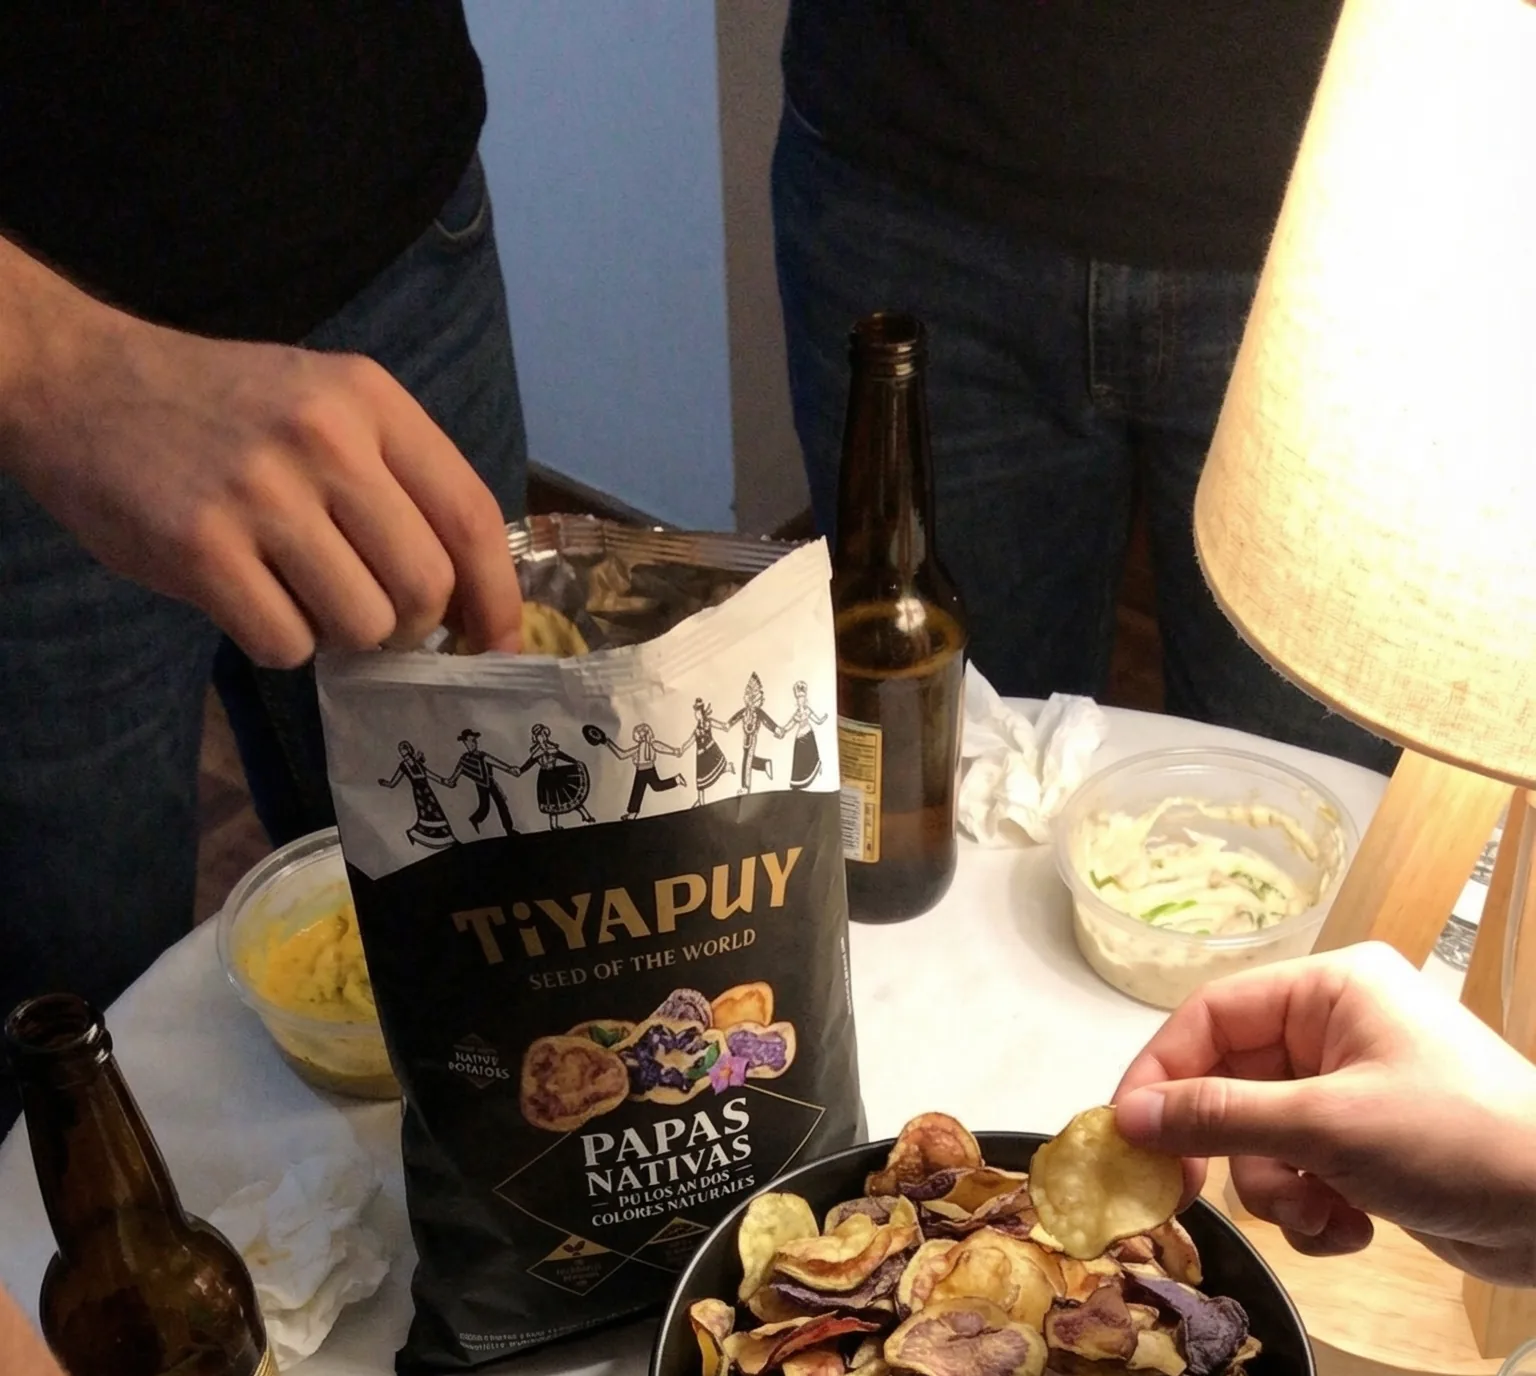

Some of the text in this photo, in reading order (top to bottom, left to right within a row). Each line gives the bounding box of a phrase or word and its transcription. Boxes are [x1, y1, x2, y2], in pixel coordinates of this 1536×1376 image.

[451, 846, 803, 965] TiYAPUY
[528, 928, 757, 991] SEED OF THE WORLD
[580, 1097, 750, 1167] PAPAS
[585, 1134, 752, 1197] NATIVAS
[644, 1185, 674, 1201] LOS
